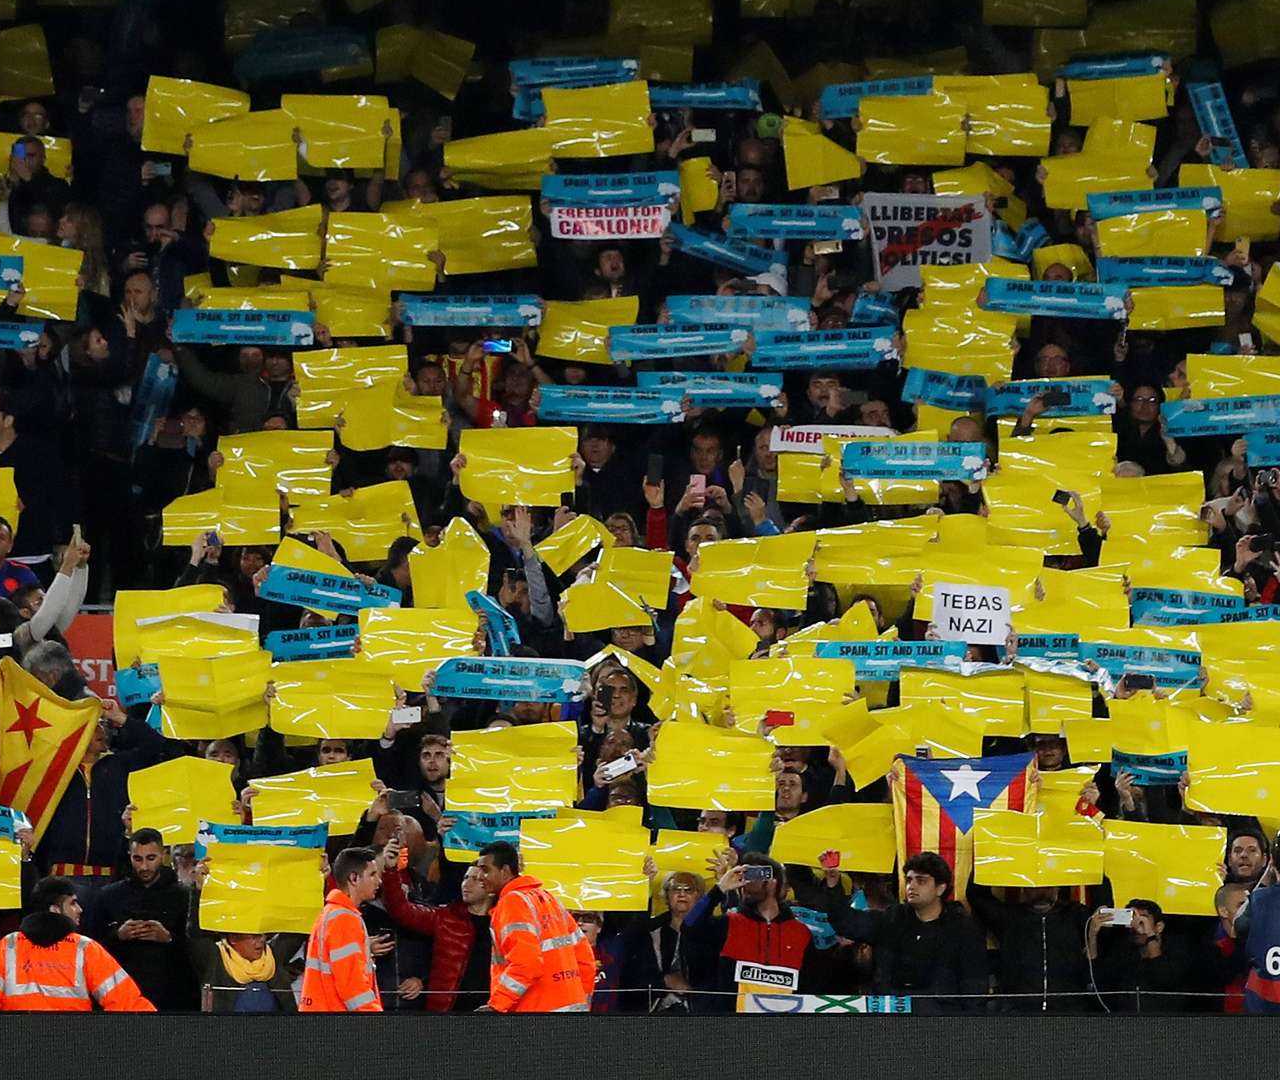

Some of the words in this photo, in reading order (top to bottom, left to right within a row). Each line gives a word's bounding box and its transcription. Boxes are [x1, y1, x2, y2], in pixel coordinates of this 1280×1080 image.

[287, 573, 318, 587] SPAIN,
[322, 578, 336, 589] SIT
[940, 592, 1002, 612] TEBAS
[1137, 592, 1165, 603] SPAIN,
[1210, 597, 1236, 608] TALK!
[1221, 611, 1252, 622] SPAIN,
[1256, 608, 1268, 618] SIT
[949, 617, 992, 634] NAZI
[282, 631, 313, 643] SPAIN,
[317, 629, 331, 641] SIT
[336, 627, 355, 638] AND
[1018, 637, 1048, 648] SPAIN,
[1053, 638, 1067, 647] SIT
[840, 646, 871, 656] SPAIN,
[876, 646, 888, 655] SIT
[893, 646, 912, 655] AND
[917, 646, 943, 655] TALK!
[455, 663, 487, 674] SPAIN,
[741, 967, 794, 987] ellesse
